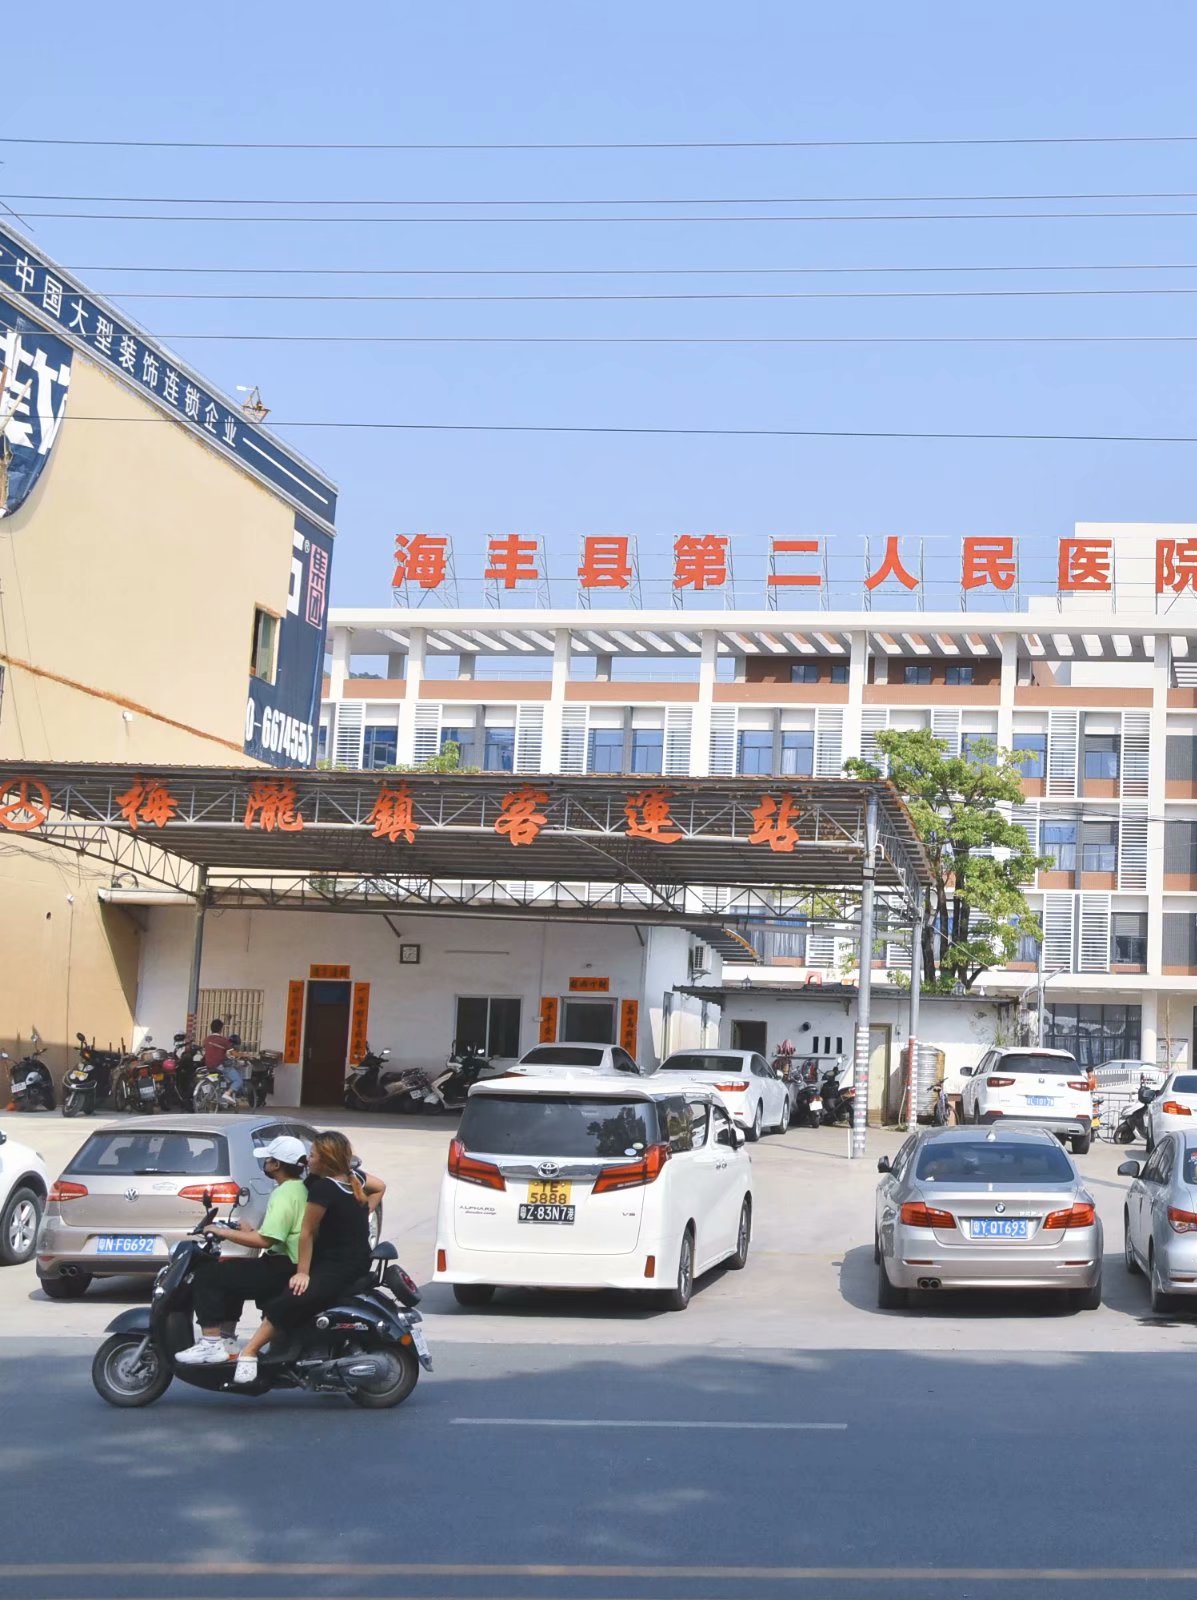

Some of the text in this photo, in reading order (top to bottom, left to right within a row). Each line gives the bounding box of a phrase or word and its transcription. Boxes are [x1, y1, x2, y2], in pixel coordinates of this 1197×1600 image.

[15, 255, 238, 448] 中国大型装饰连锁企业
[308, 546, 328, 628] 集团
[529, 1192, 568, 1205] 5888
